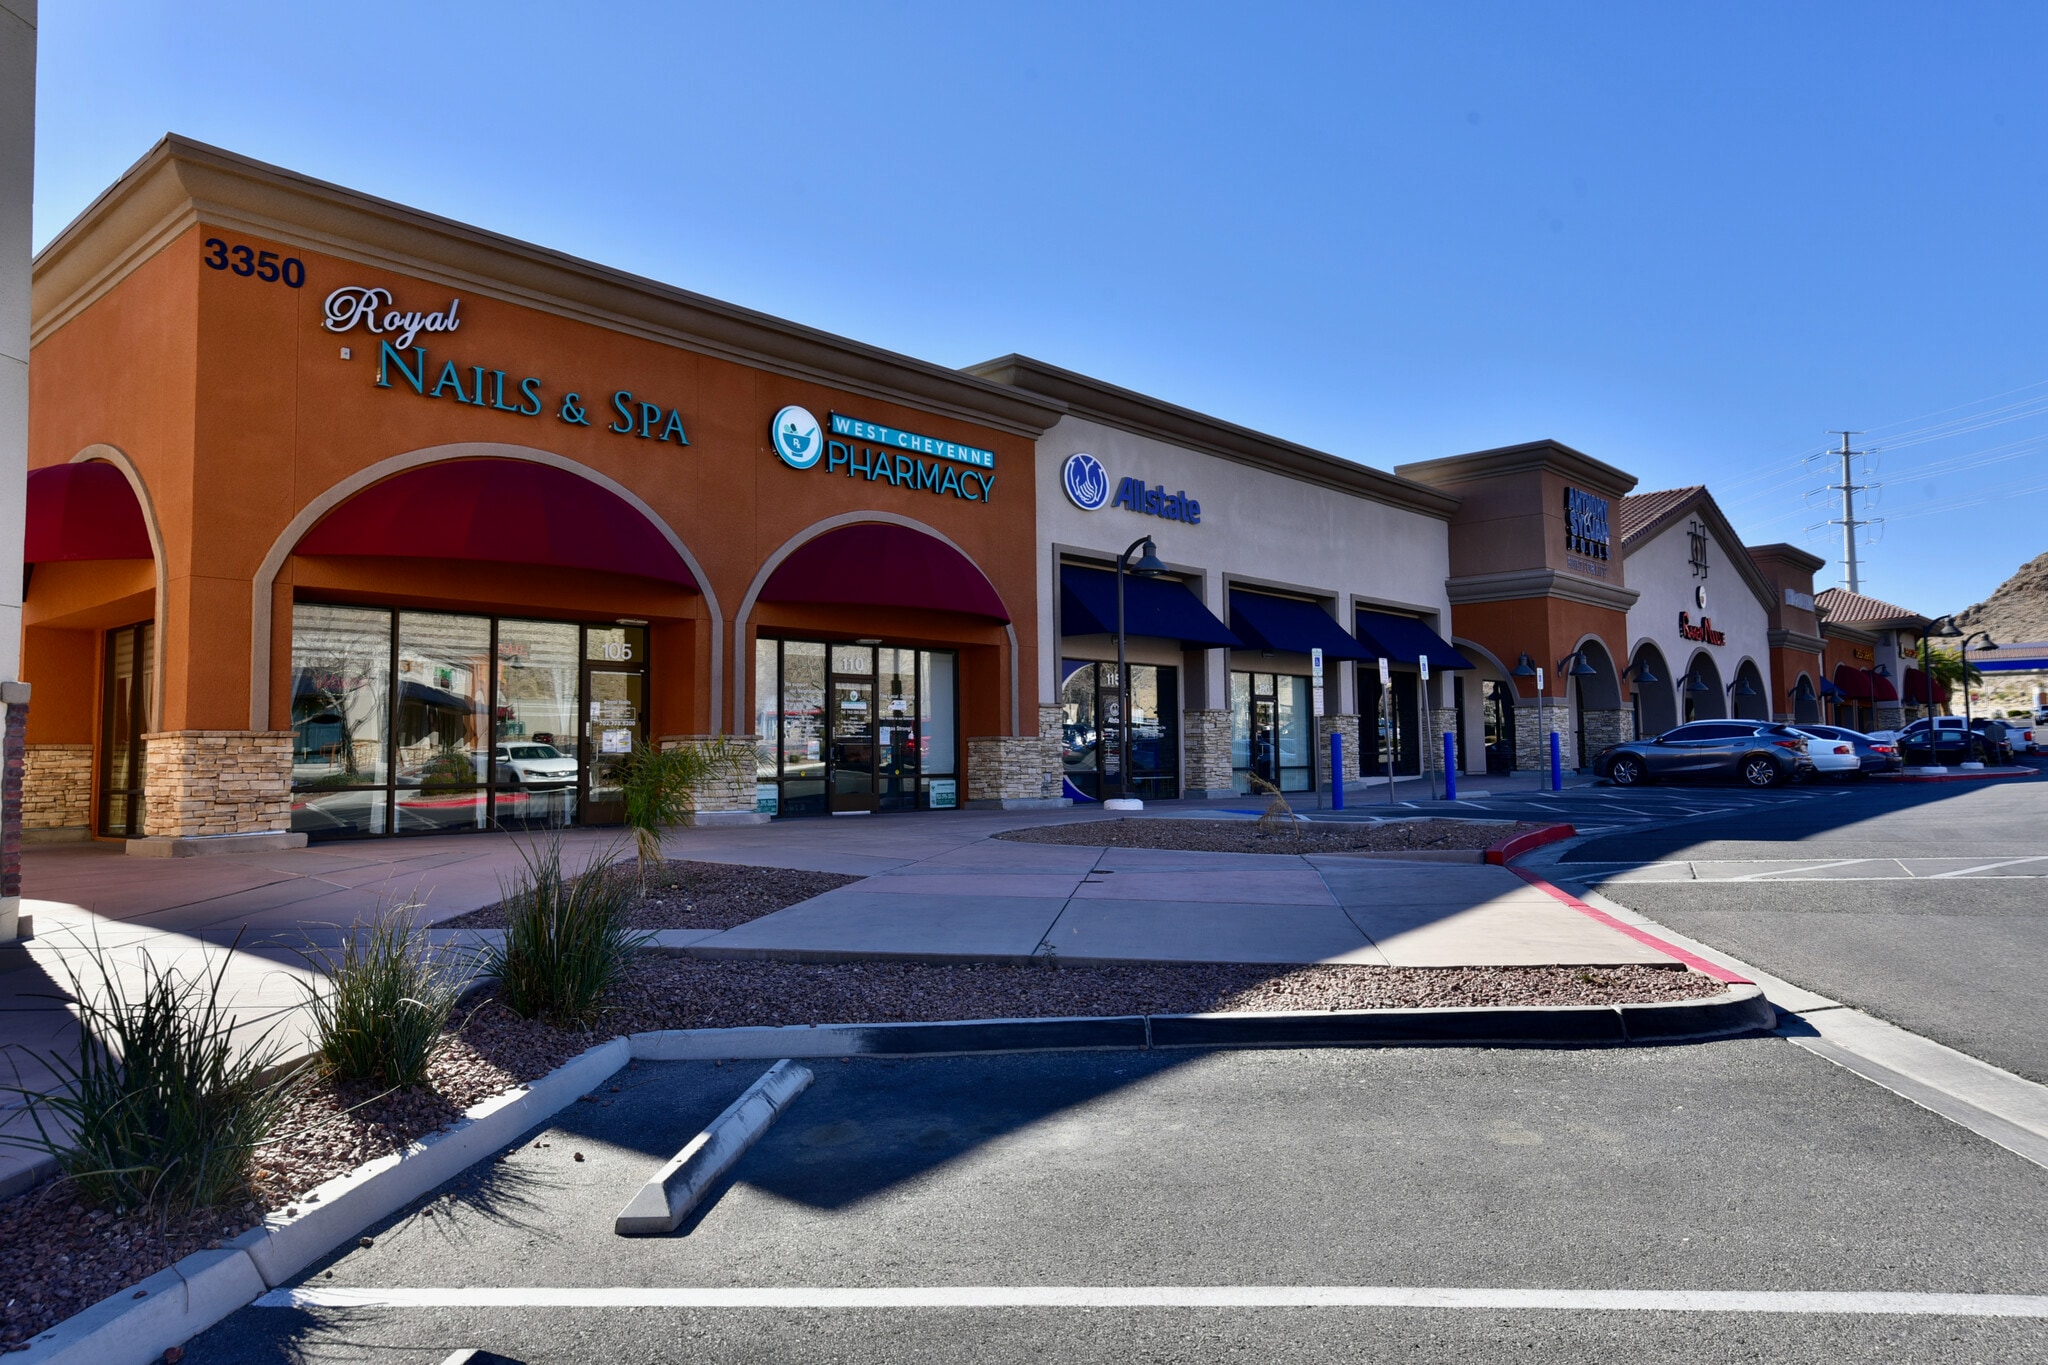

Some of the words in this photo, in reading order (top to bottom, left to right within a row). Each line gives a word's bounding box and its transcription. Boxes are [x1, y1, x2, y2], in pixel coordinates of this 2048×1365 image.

[204, 238, 305, 288] 3350
[323, 286, 460, 350] Royal
[375, 339, 542, 416] NAILS
[559, 393, 590, 426] &
[610, 391, 691, 446] SPA
[835, 417, 888, 442] WEST
[898, 433, 992, 466] CHEYENNE
[827, 440, 995, 503] PHARMACY
[1111, 476, 1201, 525] Allstate
[1570, 535, 1611, 561] POOLS
[602, 642, 633, 660] 105
[842, 656, 864, 671] 110
